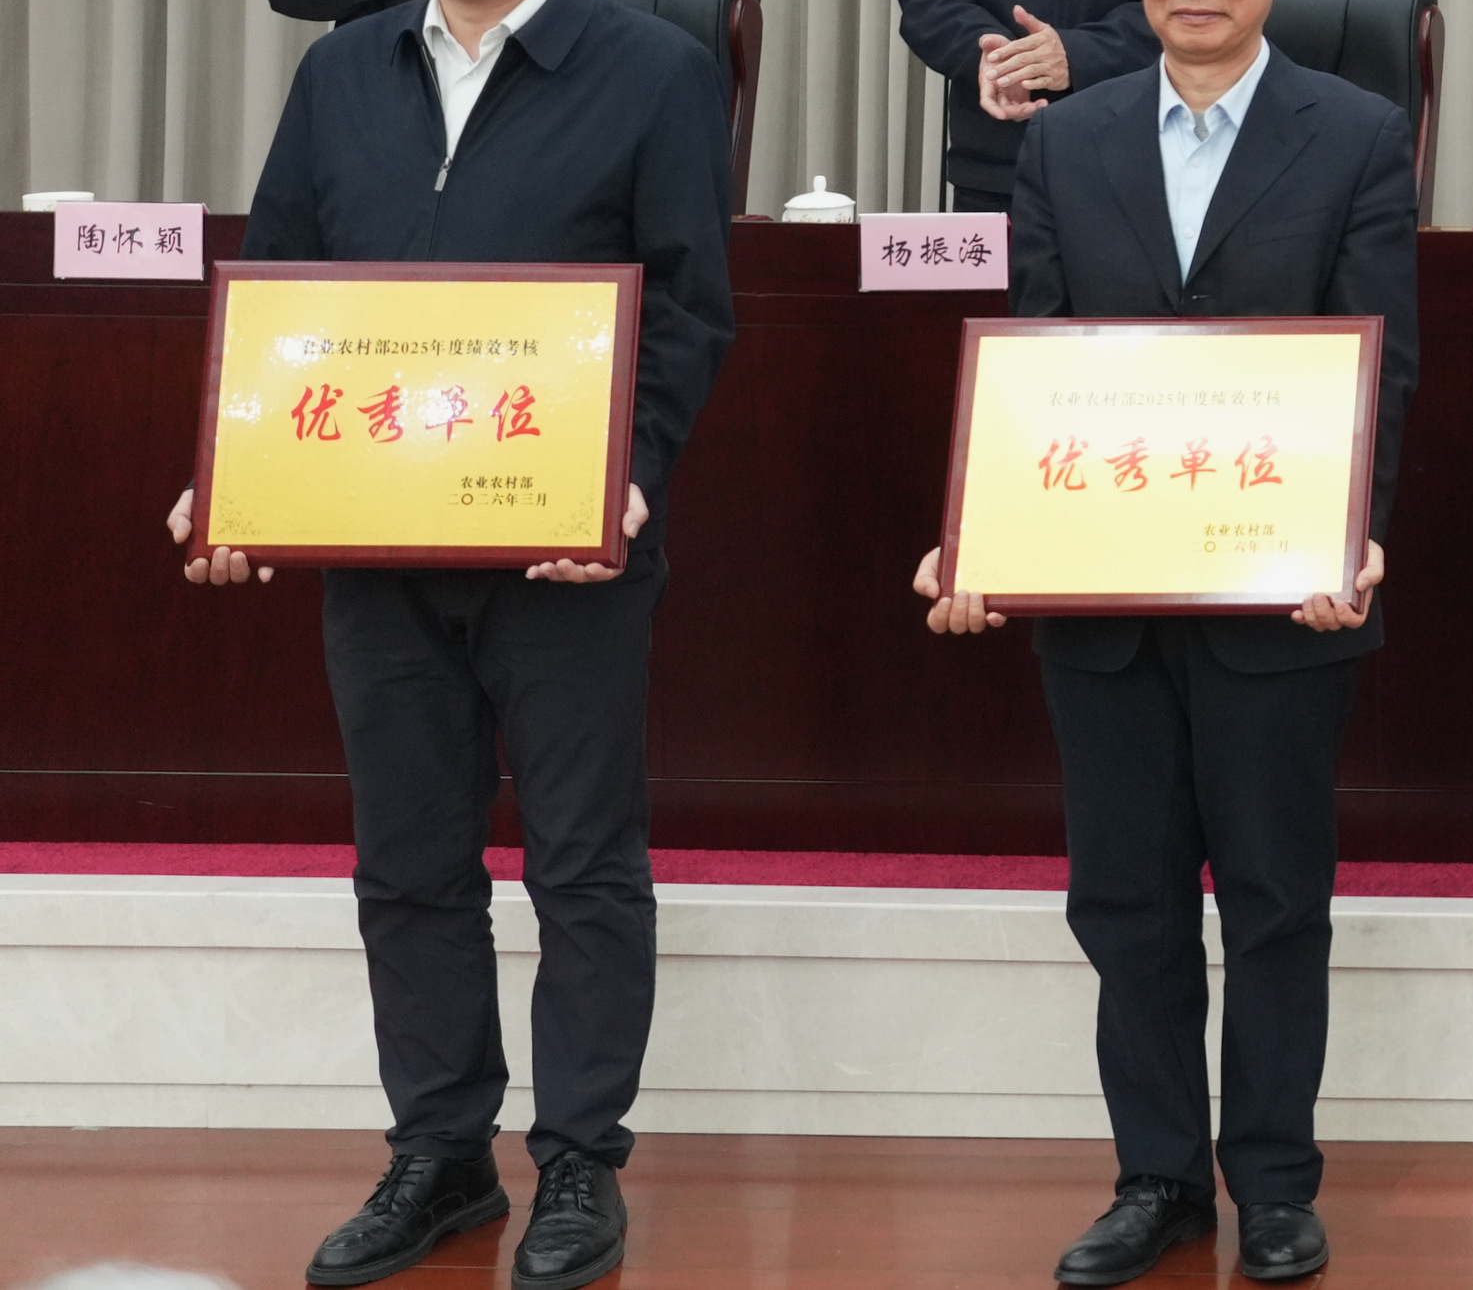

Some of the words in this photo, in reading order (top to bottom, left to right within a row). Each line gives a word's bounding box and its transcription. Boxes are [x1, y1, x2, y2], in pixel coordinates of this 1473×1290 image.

[77, 223, 183, 254] 陶怀颖
[882, 233, 992, 267] 杨振海
[1039, 435, 1283, 492] 优秀单位
[461, 475, 533, 489] 农业农村部
[447, 493, 548, 506] 二〇二六年三月
[1204, 524, 1275, 536] 农业农村部
